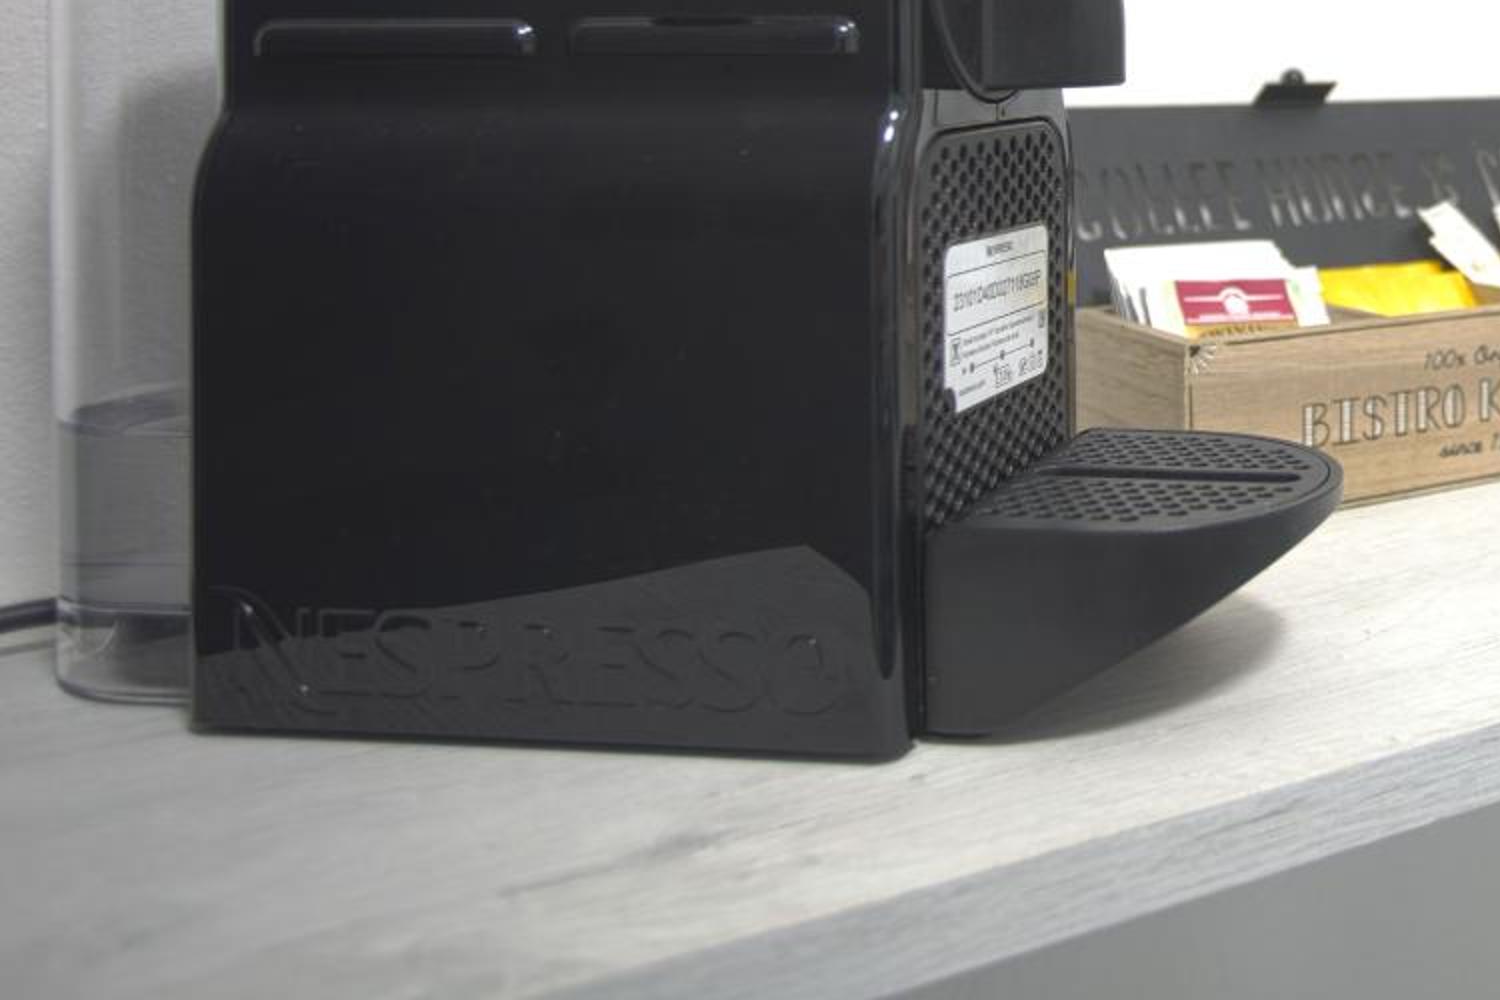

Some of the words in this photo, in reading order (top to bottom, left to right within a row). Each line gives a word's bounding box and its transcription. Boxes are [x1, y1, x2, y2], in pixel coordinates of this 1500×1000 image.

[1302, 384, 1466, 449] BISTRO
[1438, 440, 1483, 458] since
[206, 584, 848, 716] NESPRESSO
